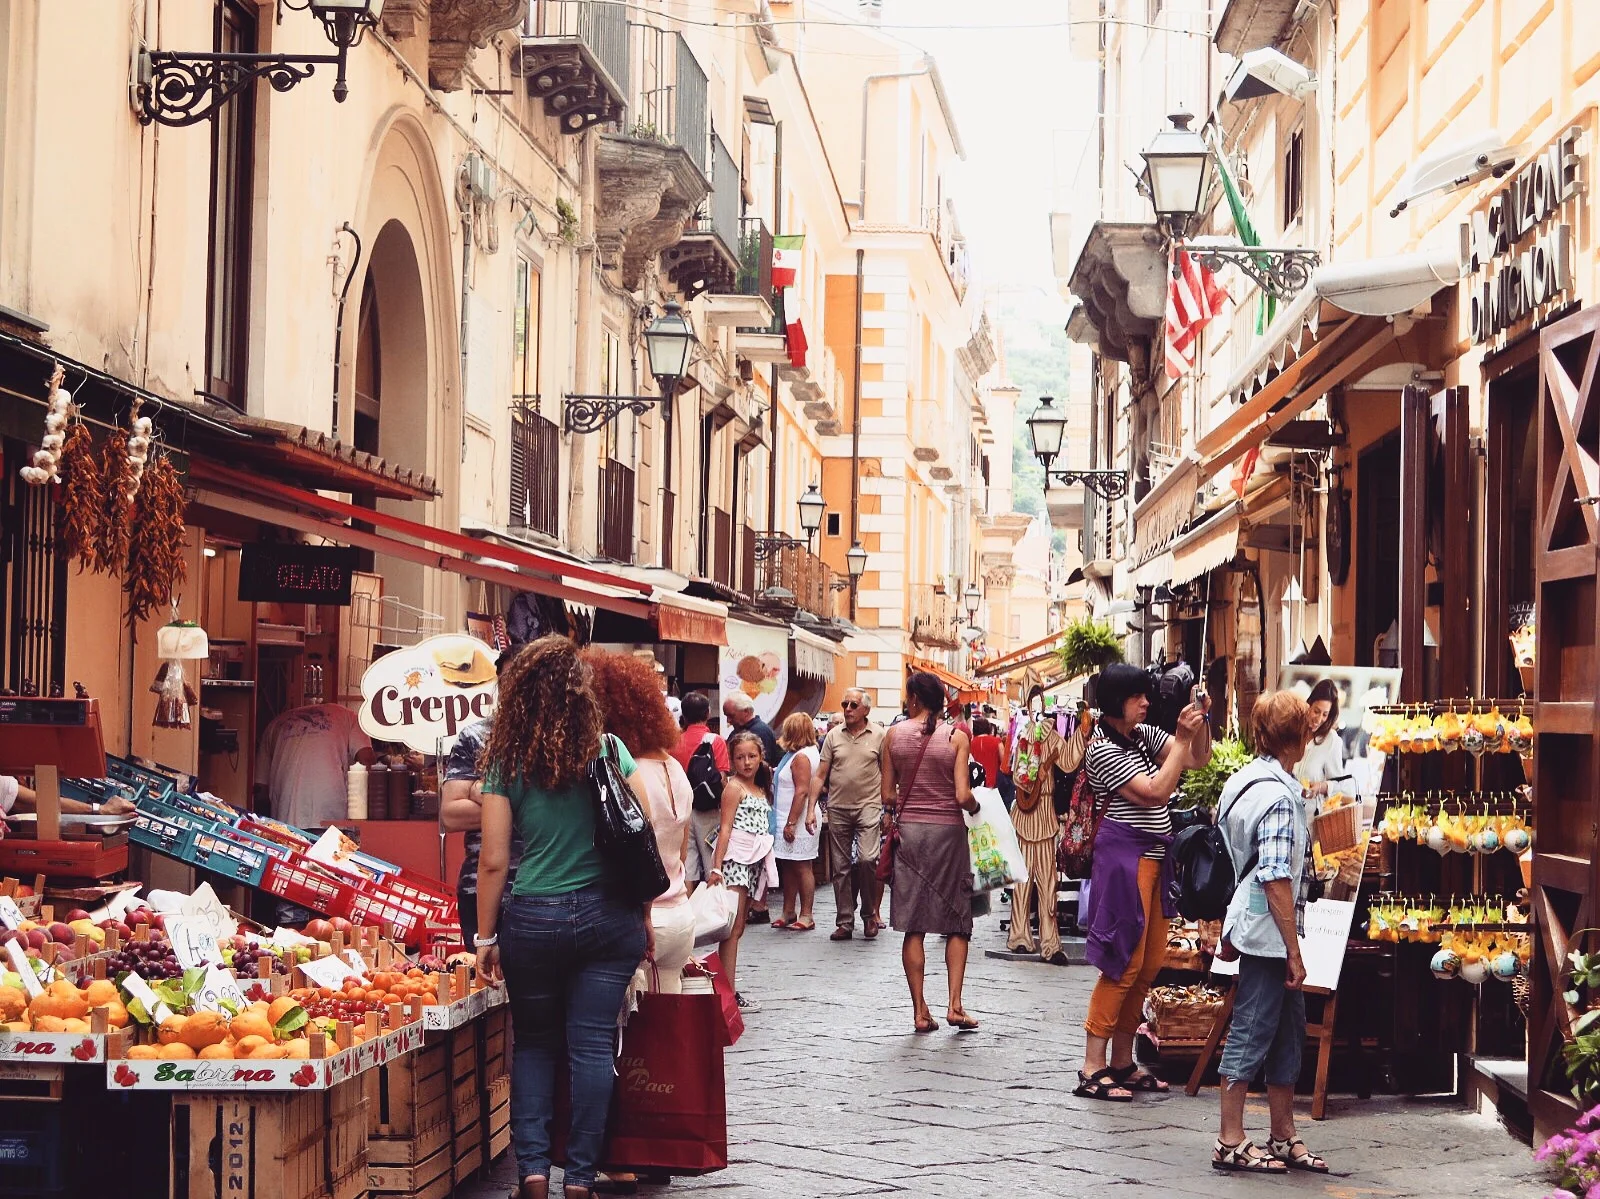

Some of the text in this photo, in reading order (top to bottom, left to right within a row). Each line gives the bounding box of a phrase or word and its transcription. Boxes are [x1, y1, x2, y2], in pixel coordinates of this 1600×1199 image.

[1488, 126, 1584, 258] CANZONE
[1471, 282, 1490, 346] DI
[277, 564, 341, 591] GELATO
[371, 685, 494, 737] Crepe
[154, 1061, 276, 1082] Sabrina
